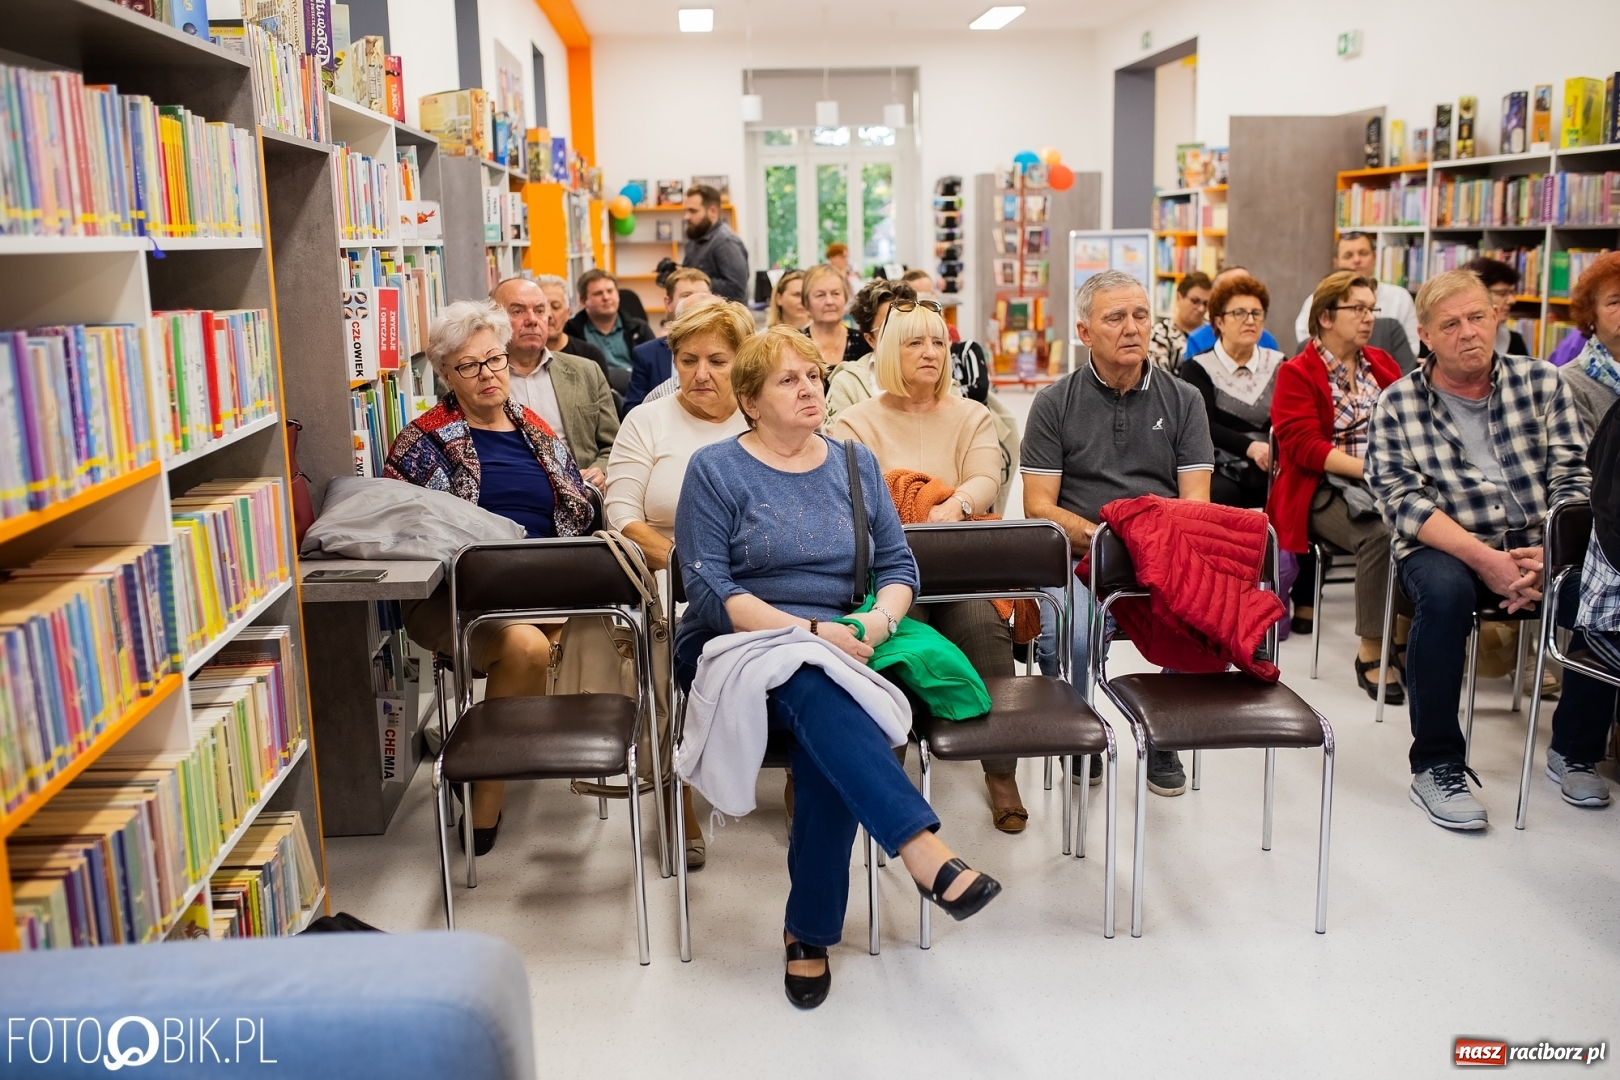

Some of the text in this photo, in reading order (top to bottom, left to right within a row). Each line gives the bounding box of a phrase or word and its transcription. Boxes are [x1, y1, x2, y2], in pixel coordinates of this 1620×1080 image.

[351, 321, 364, 378] CZŁOWIEK
[380, 312, 388, 351] OBYCZAJE
[389, 310, 397, 351] ZWYCZAJE
[384, 729, 396, 779] CHEMIA
